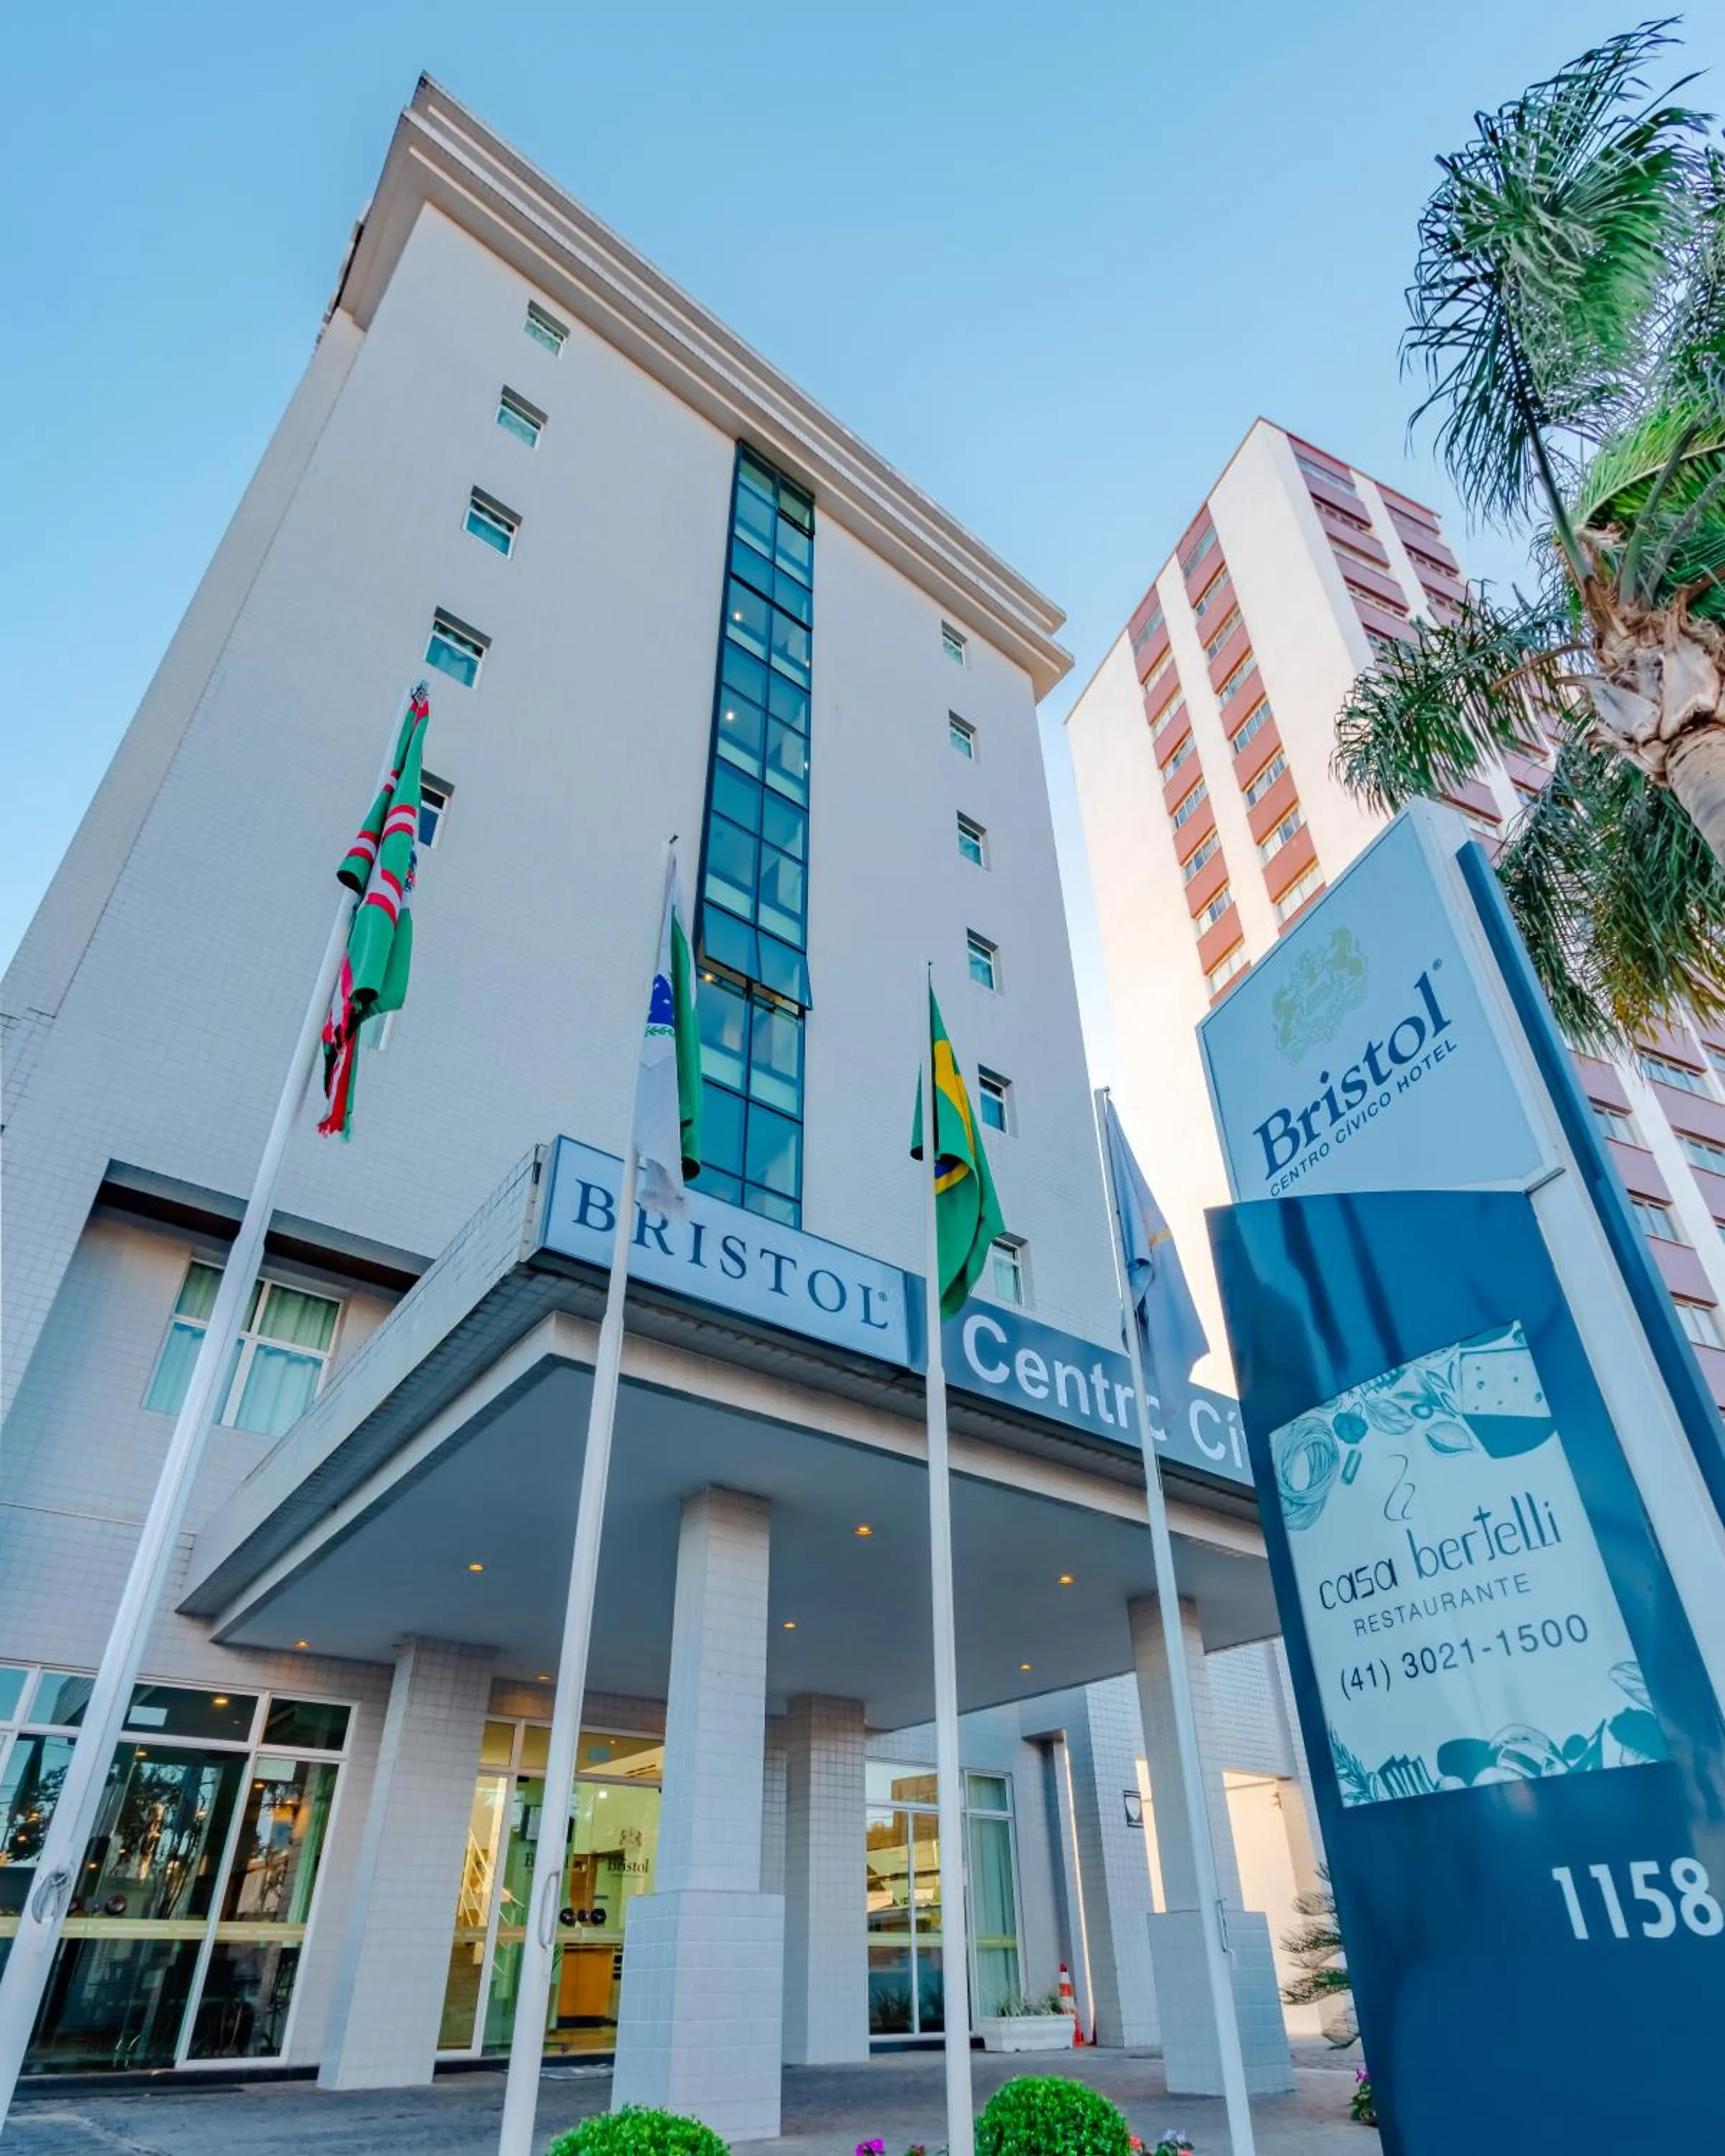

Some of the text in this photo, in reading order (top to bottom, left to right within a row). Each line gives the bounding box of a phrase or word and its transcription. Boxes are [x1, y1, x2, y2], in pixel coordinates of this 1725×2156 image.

[1253, 970, 1451, 1180] Bristol
[1270, 1039, 1458, 1197] CENTRO CÍVICO HOTEL
[572, 1179, 888, 1330] BRISTOL
[1319, 1491, 1561, 1609] casa bertelli
[1354, 1572, 1531, 1636] RESTAURANTE
[1339, 1613, 1588, 1700] (41) 3021-1500
[1551, 1857, 1724, 1940] 1158
